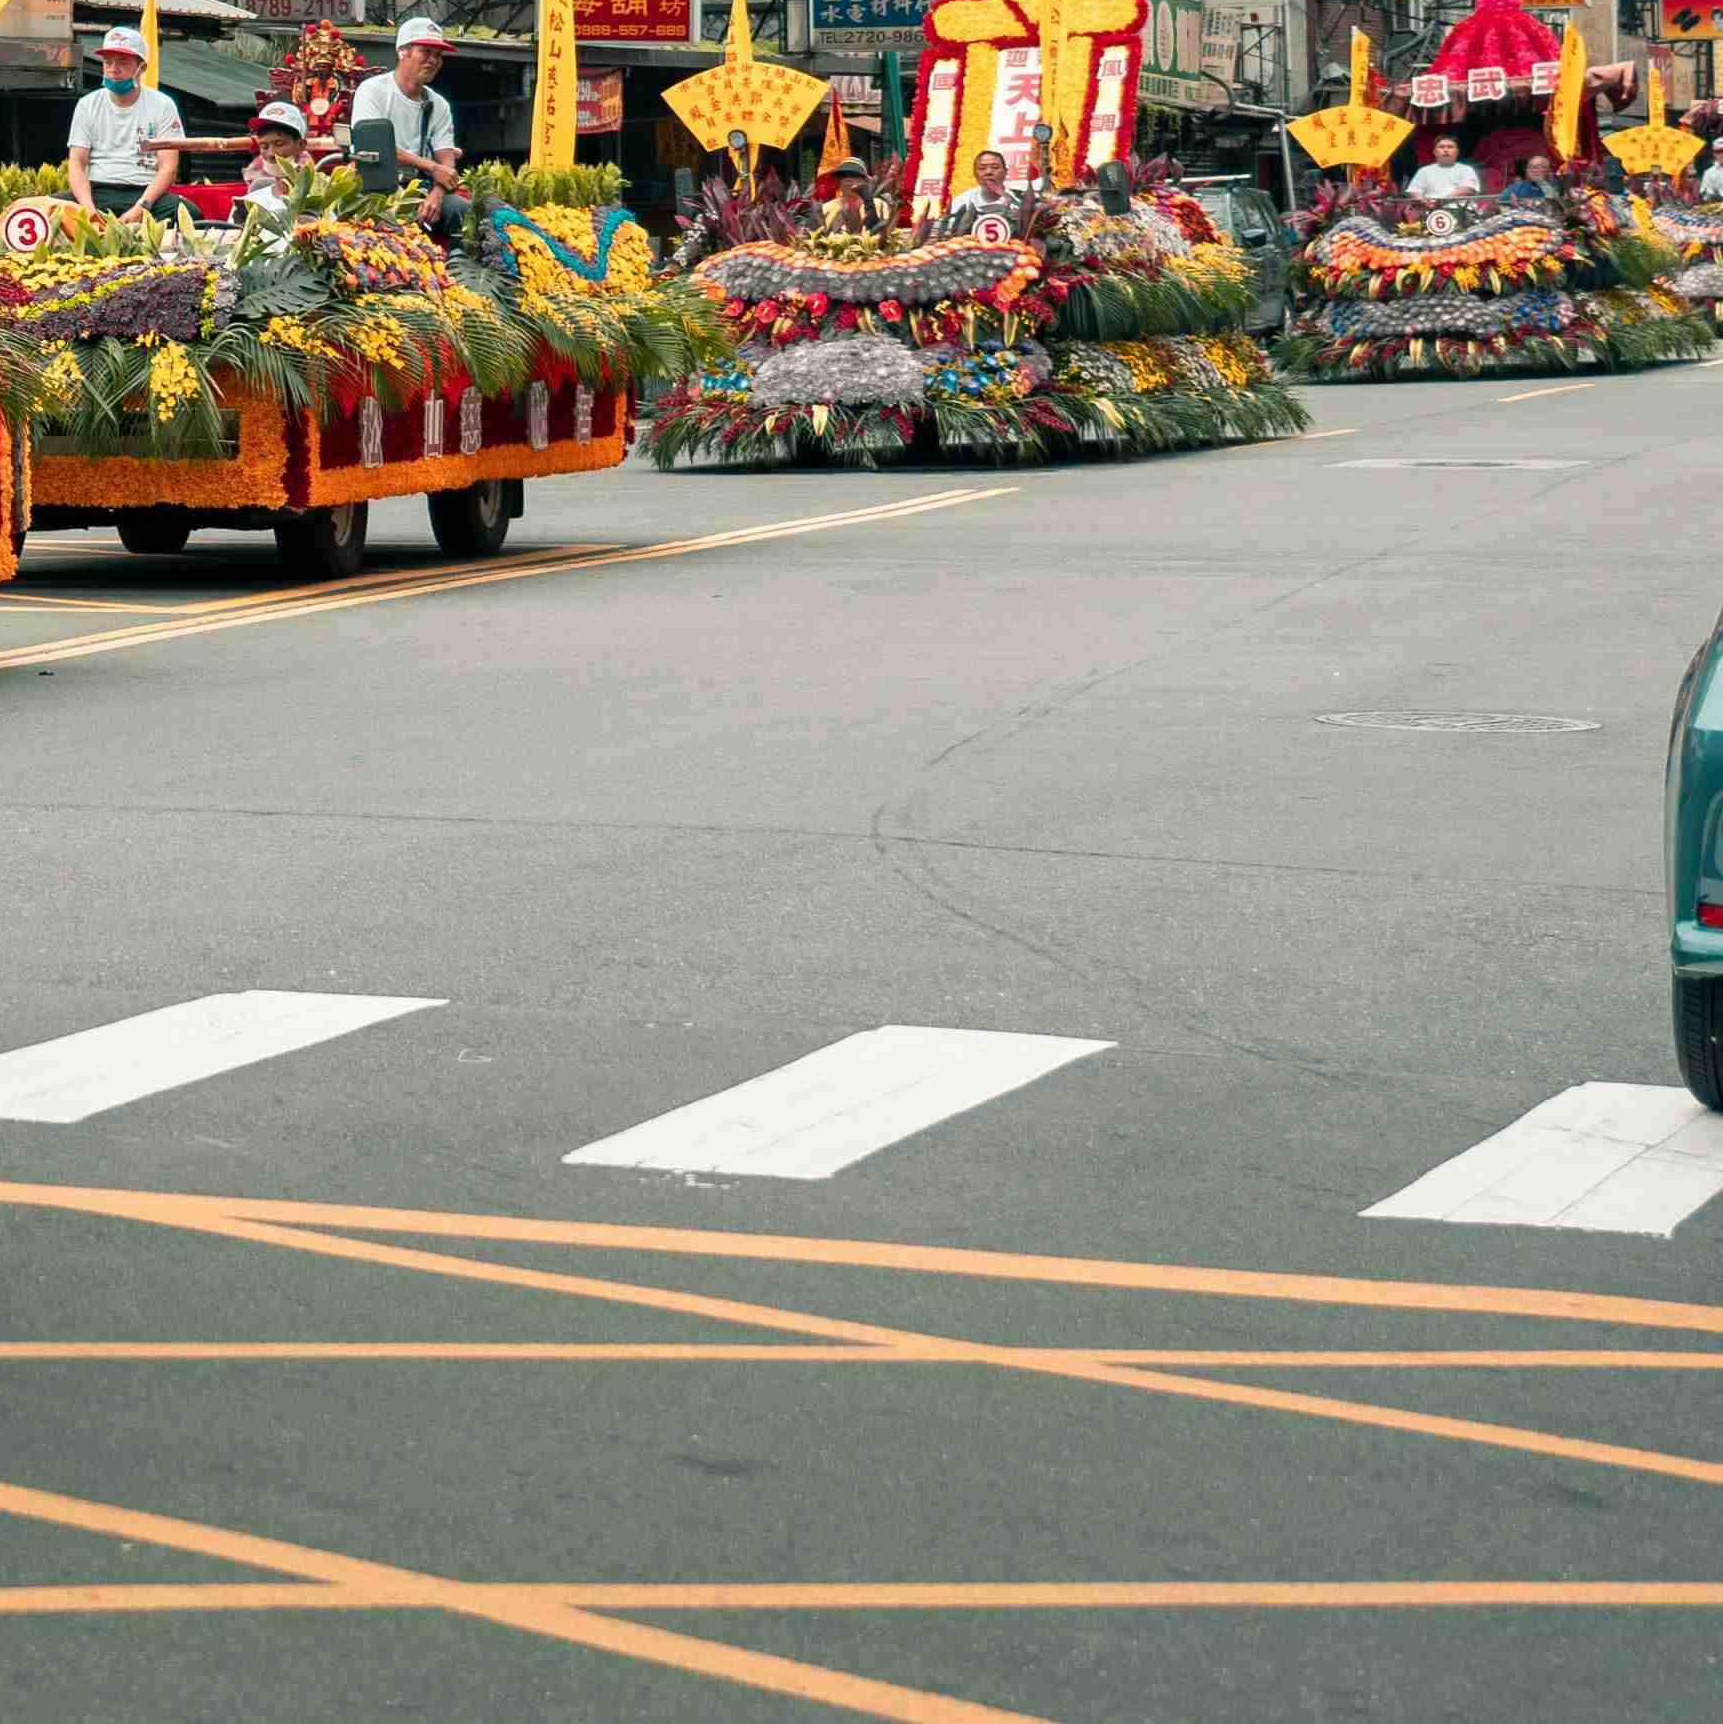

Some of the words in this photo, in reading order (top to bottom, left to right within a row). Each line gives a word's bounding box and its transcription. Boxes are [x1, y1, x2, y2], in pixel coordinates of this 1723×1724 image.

[17, 217, 38, 246] 3
[1434, 216, 1446, 229] 6
[985, 223, 999, 243] 5
